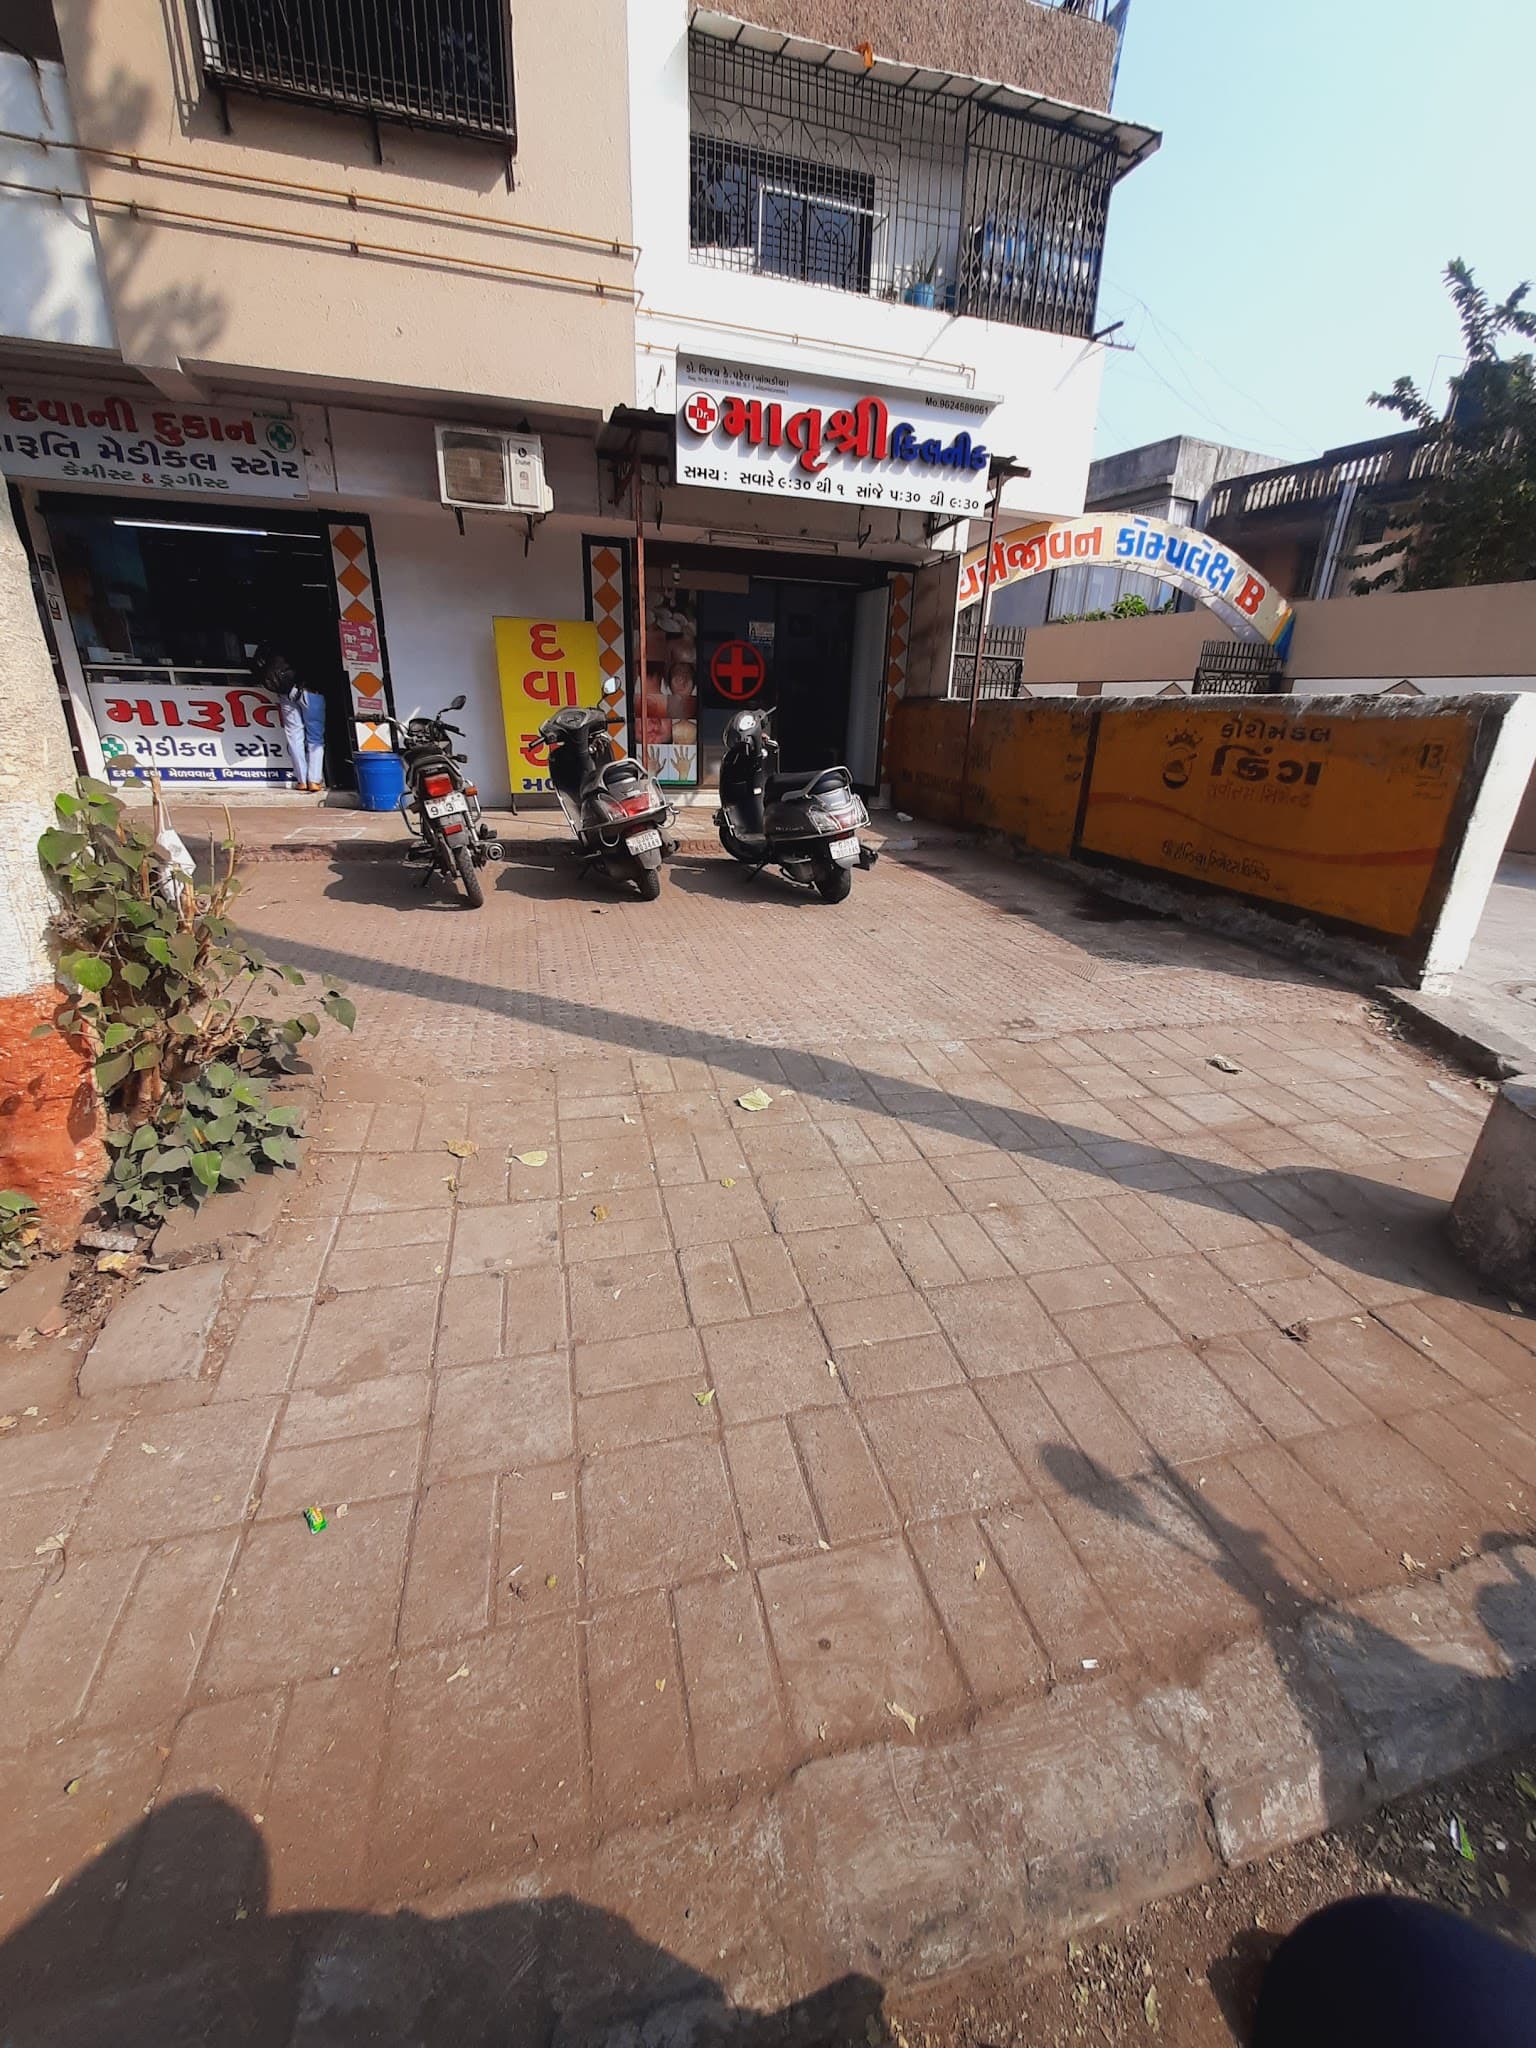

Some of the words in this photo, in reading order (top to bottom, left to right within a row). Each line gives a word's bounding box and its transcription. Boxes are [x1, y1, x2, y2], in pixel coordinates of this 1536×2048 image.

[7, 395, 138, 433] દવાની
[154, 411, 257, 447] દુકાન
[722, 395, 889, 473] માતૃશ્રી
[98, 437, 217, 472] મેડીકલ
[230, 450, 300, 480] સ્ટોર
[141, 472, 152, 484] &
[739, 469, 774, 489] સવારે
[816, 478, 832, 495] થી
[856, 483, 884, 501] સાંજે
[929, 492, 944, 508] થી
[1234, 575, 1266, 617] B
[105, 690, 285, 733] મારૂતિ
[135, 735, 217, 758] મેડીકલ
[234, 735, 283, 758] સ્ટોર
